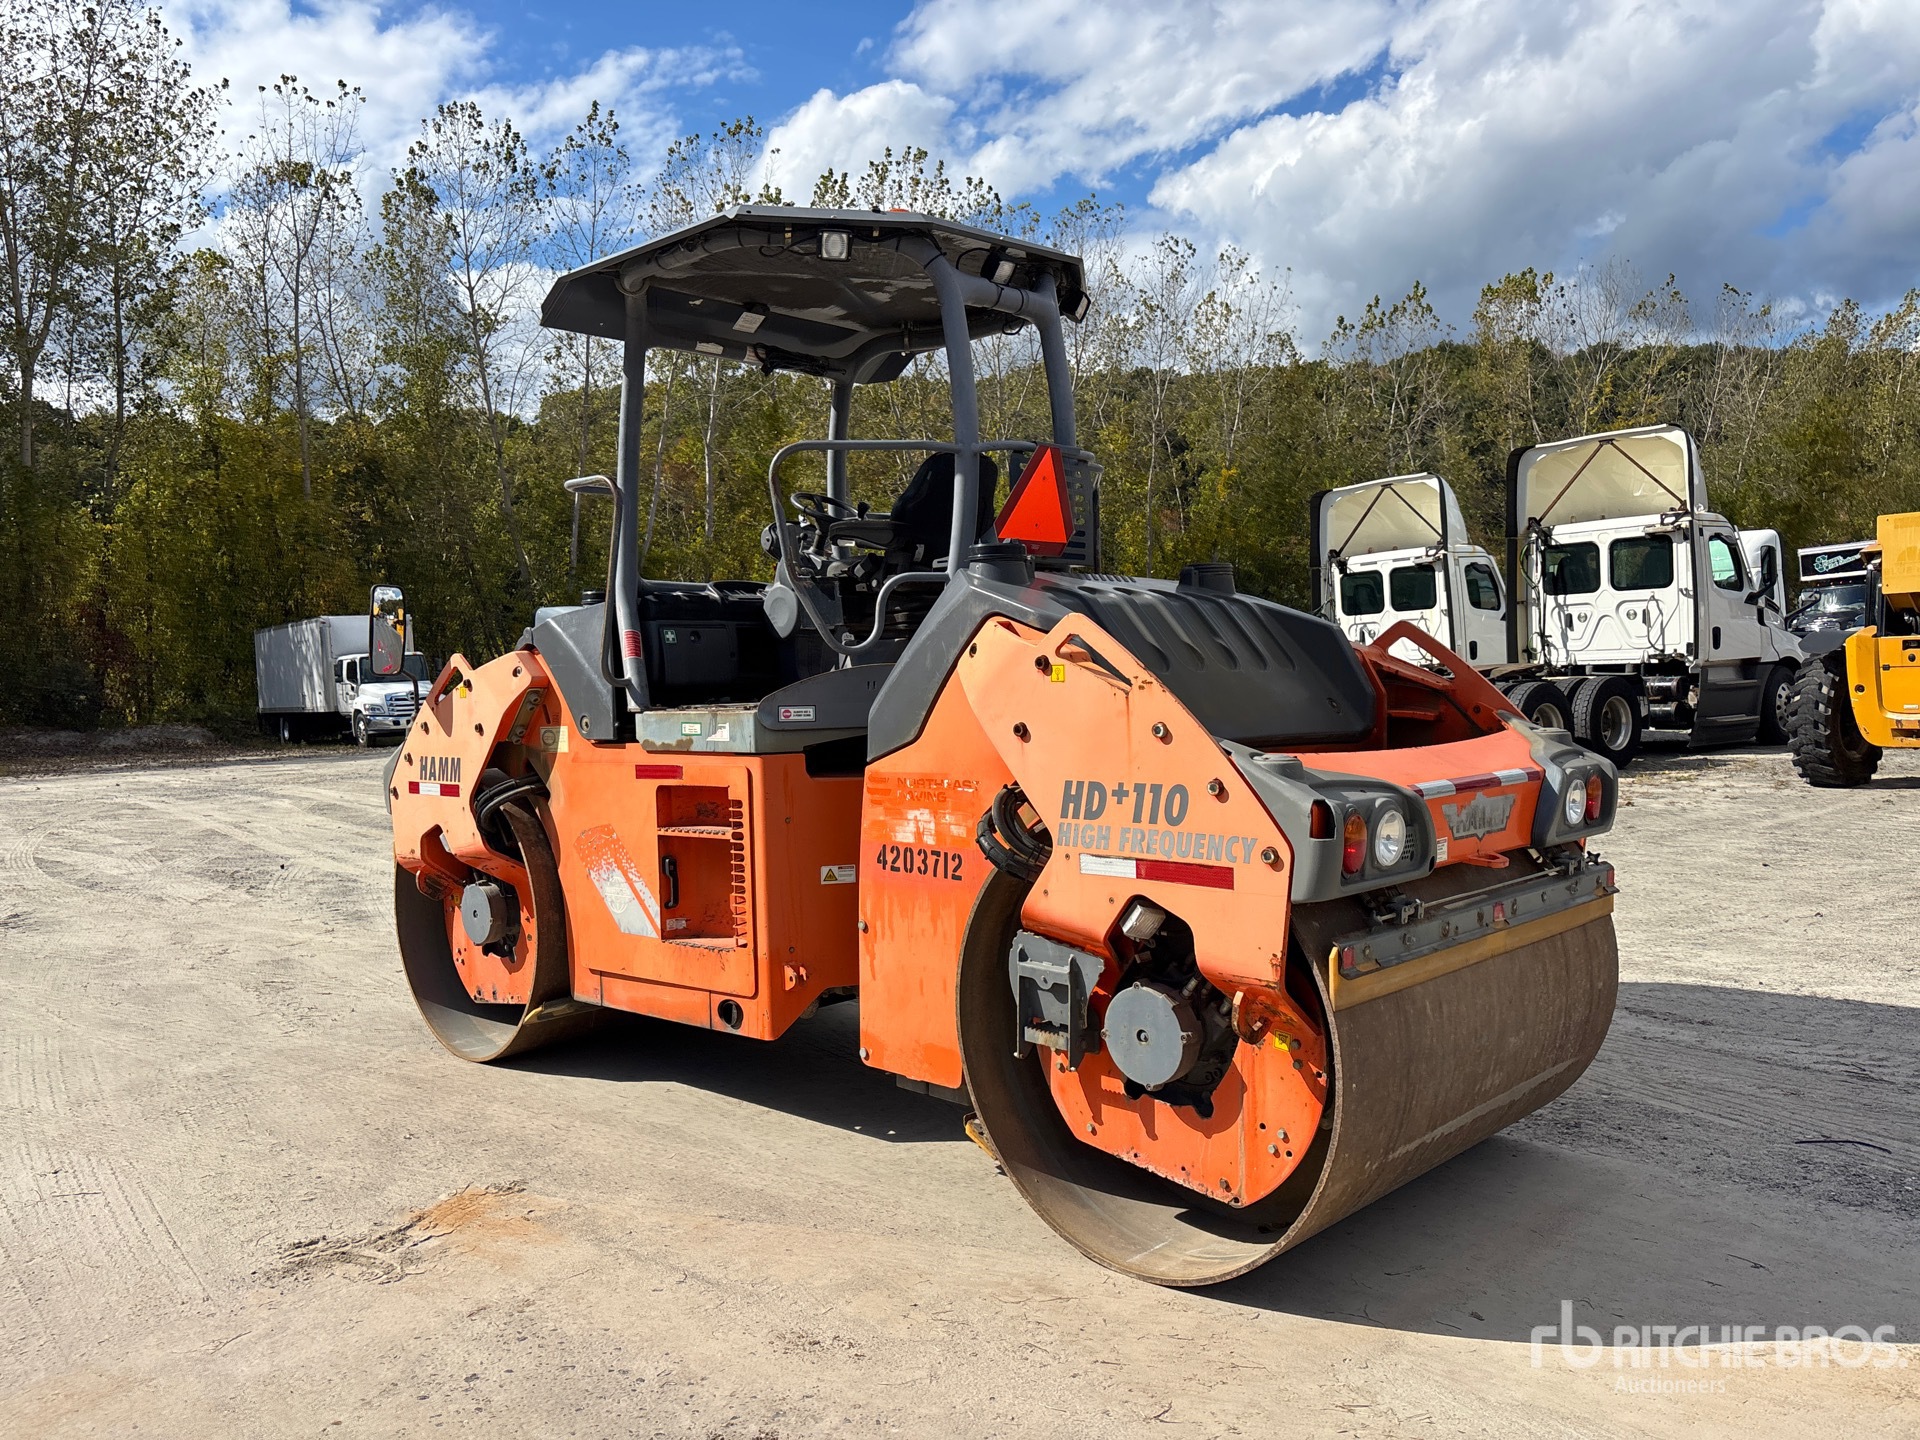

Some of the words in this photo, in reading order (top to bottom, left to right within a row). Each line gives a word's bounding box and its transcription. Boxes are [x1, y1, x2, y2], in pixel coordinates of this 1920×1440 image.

[420, 756, 461, 782] HAMM
[1059, 780, 1189, 826] HD+110
[876, 844, 964, 881] 4203712
[1057, 822, 1111, 851] HIGH
[1117, 827, 1258, 865] FREQUENCY
